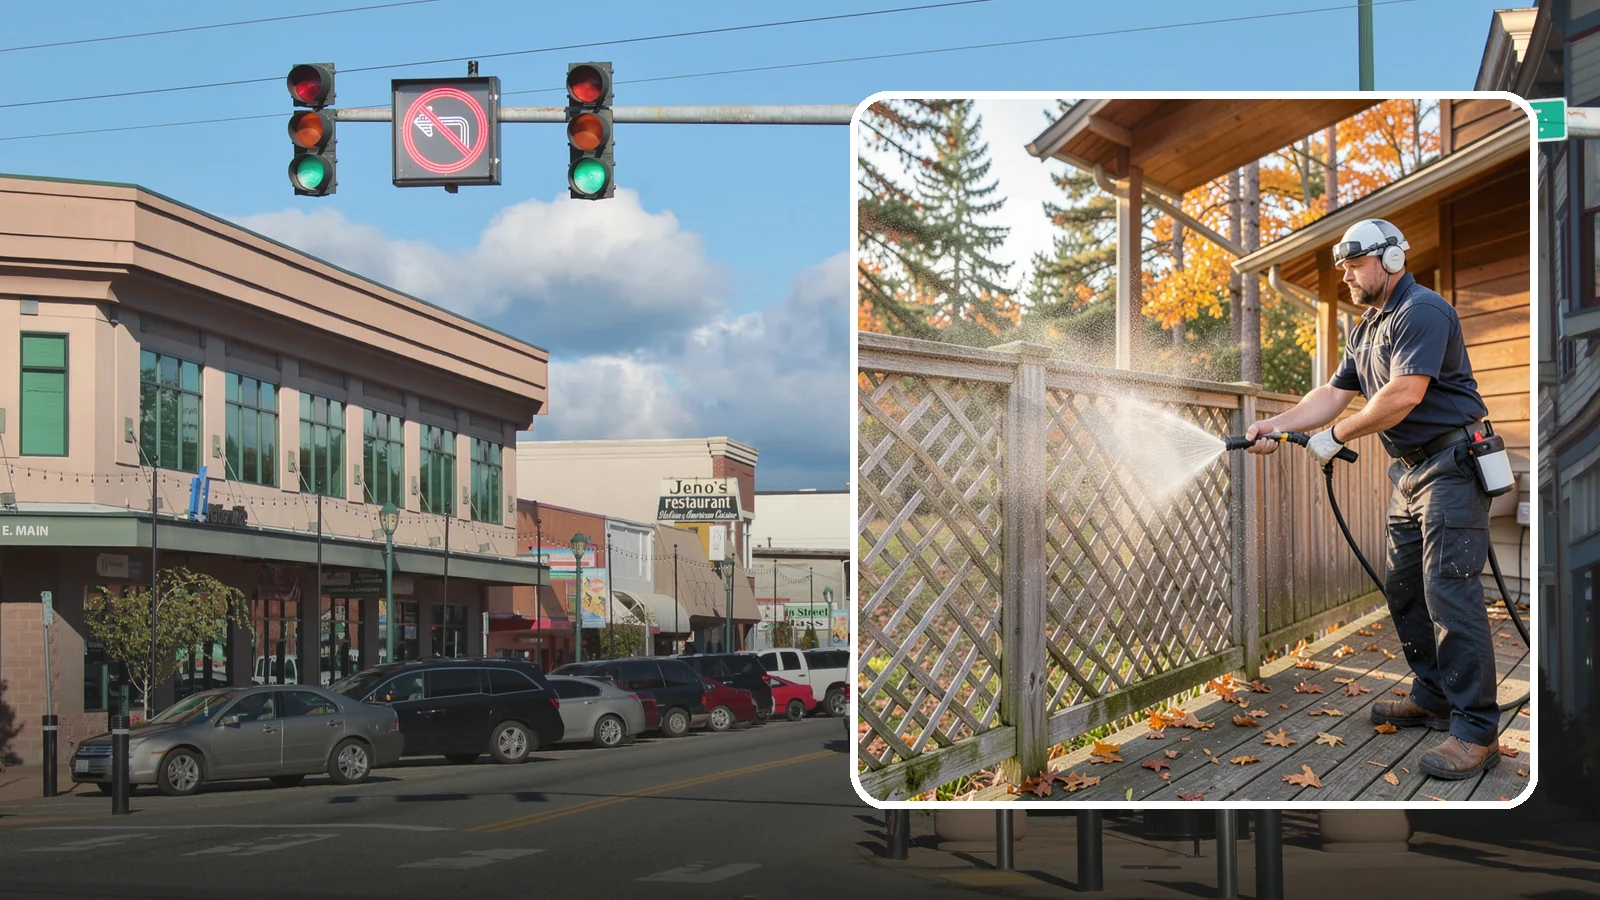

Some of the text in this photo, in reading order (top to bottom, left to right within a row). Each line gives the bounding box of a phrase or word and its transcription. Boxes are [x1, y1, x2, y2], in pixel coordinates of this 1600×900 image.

[669, 480, 728, 495] Jeno's
[665, 496, 731, 509] restaurant
[658, 509, 681, 519] Italian
[686, 509, 714, 519] American
[715, 509, 738, 519] Cuisine
[2, 525, 49, 536] E. MAIN
[797, 607, 828, 616] Street
[790, 619, 824, 627] lass
